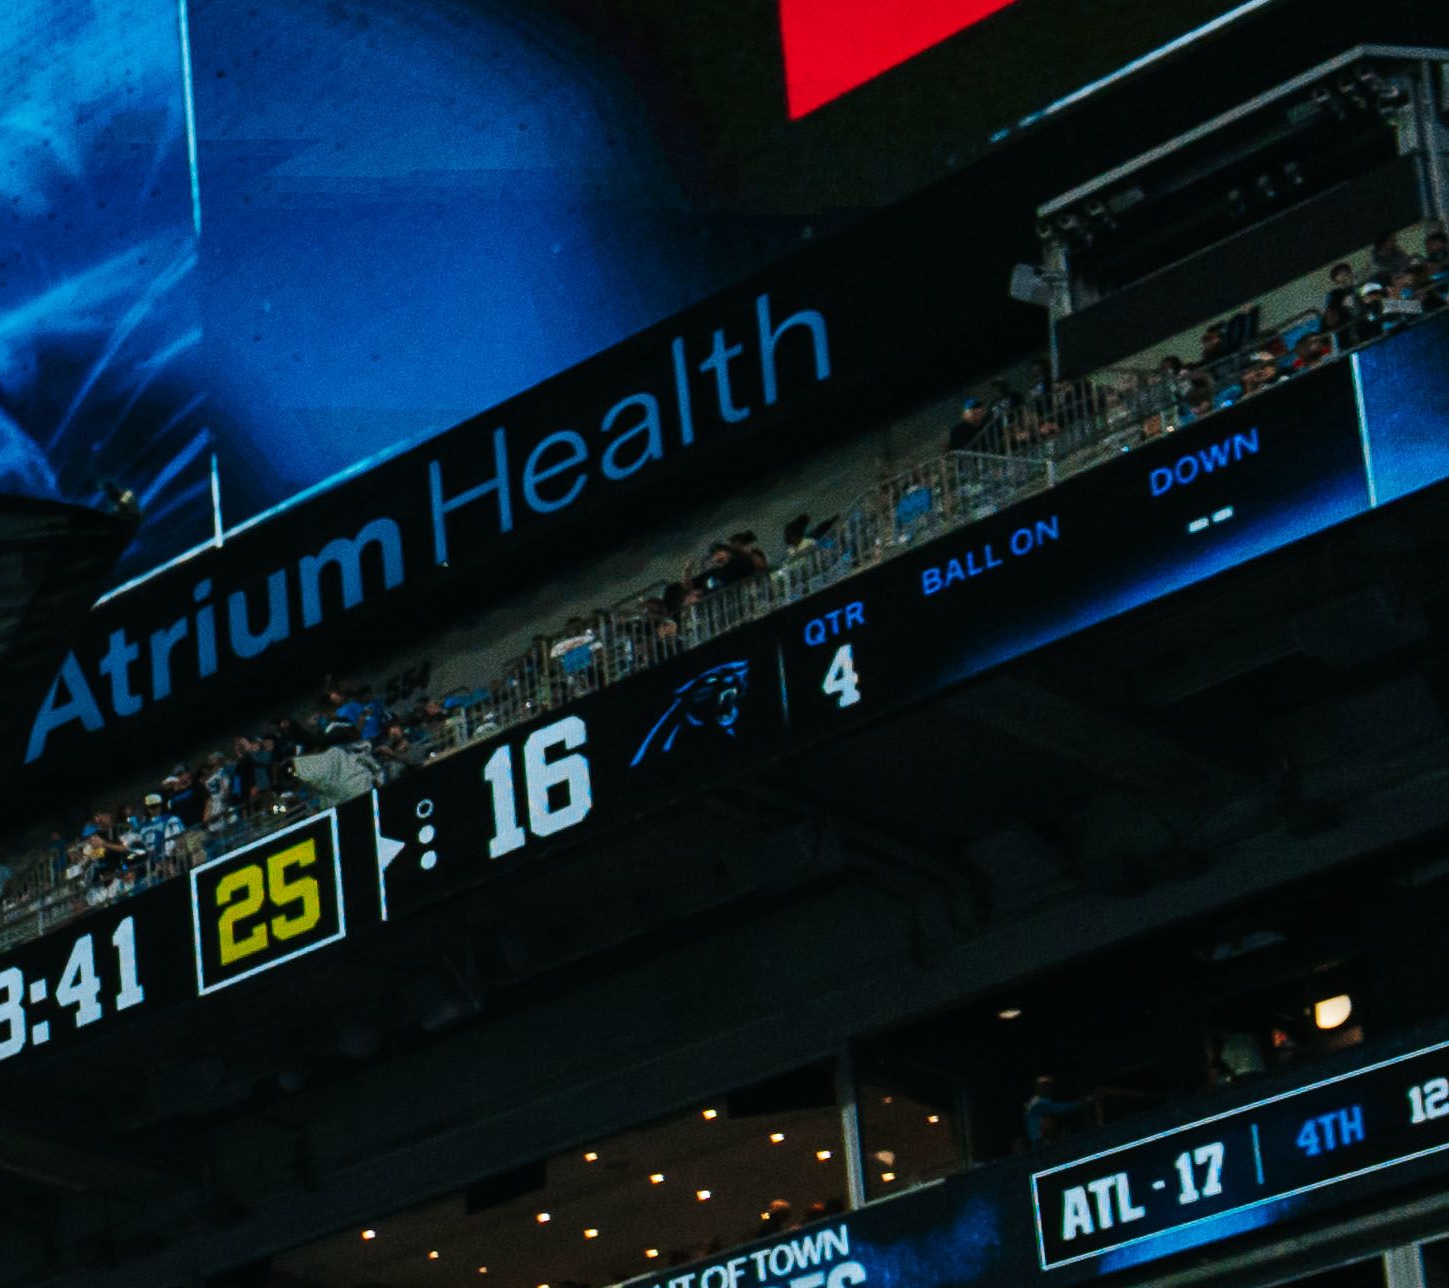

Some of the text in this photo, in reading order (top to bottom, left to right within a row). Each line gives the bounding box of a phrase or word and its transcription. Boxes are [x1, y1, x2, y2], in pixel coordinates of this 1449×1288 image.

[1150, 428, 1260, 496] DOWN
[25, 293, 831, 765] Atrium Health
[922, 516, 1060, 595] BALL ON
[804, 601, 866, 647] QTR
[823, 644, 860, 707] 4
[484, 715, 591, 858] 16
[216, 839, 322, 967] 25
[1295, 1105, 1366, 1157] 4TH
[1062, 1172, 1145, 1241] ATL
[1174, 1142, 1225, 1206] 17
[750, 1224, 849, 1282] TOWN
